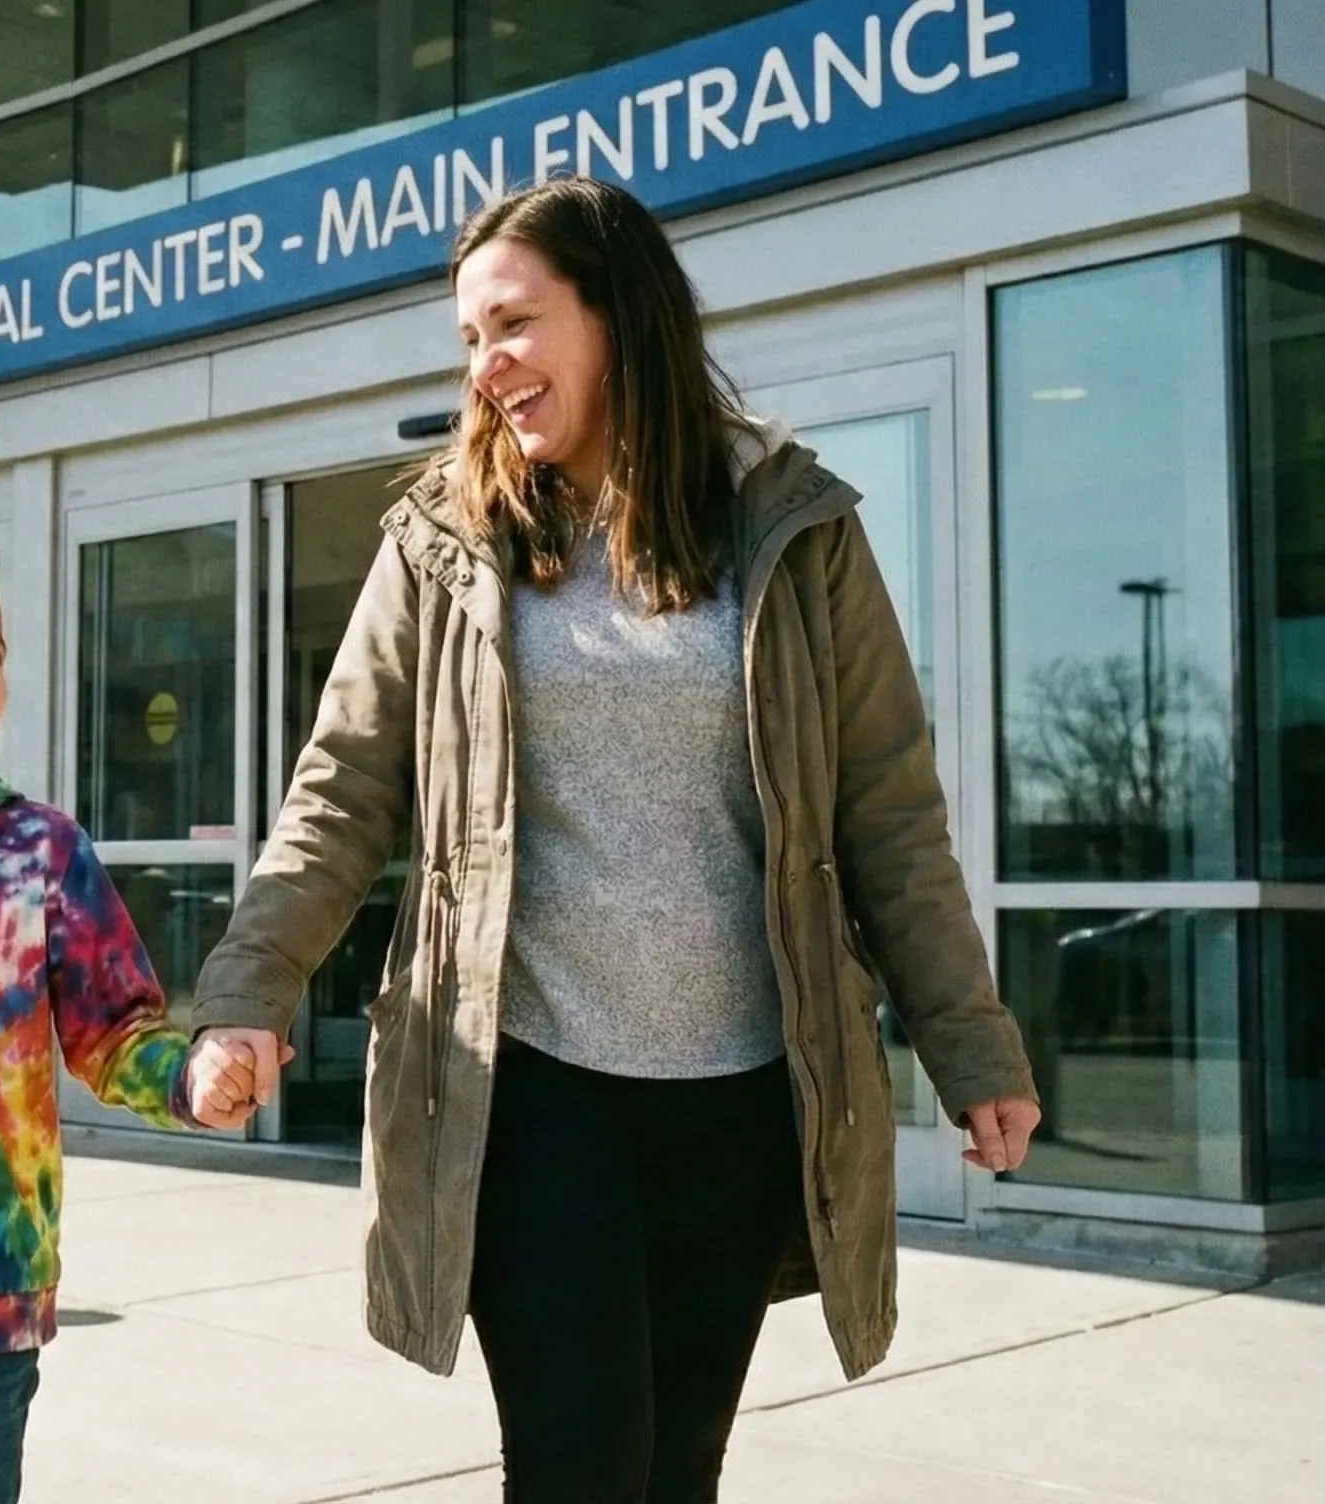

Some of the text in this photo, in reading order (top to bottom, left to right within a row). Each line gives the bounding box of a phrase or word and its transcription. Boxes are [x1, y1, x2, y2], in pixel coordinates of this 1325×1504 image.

[59, 212, 266, 329] CENTER
[282, 235, 303, 251] -
[317, 136, 505, 264] MAIN
